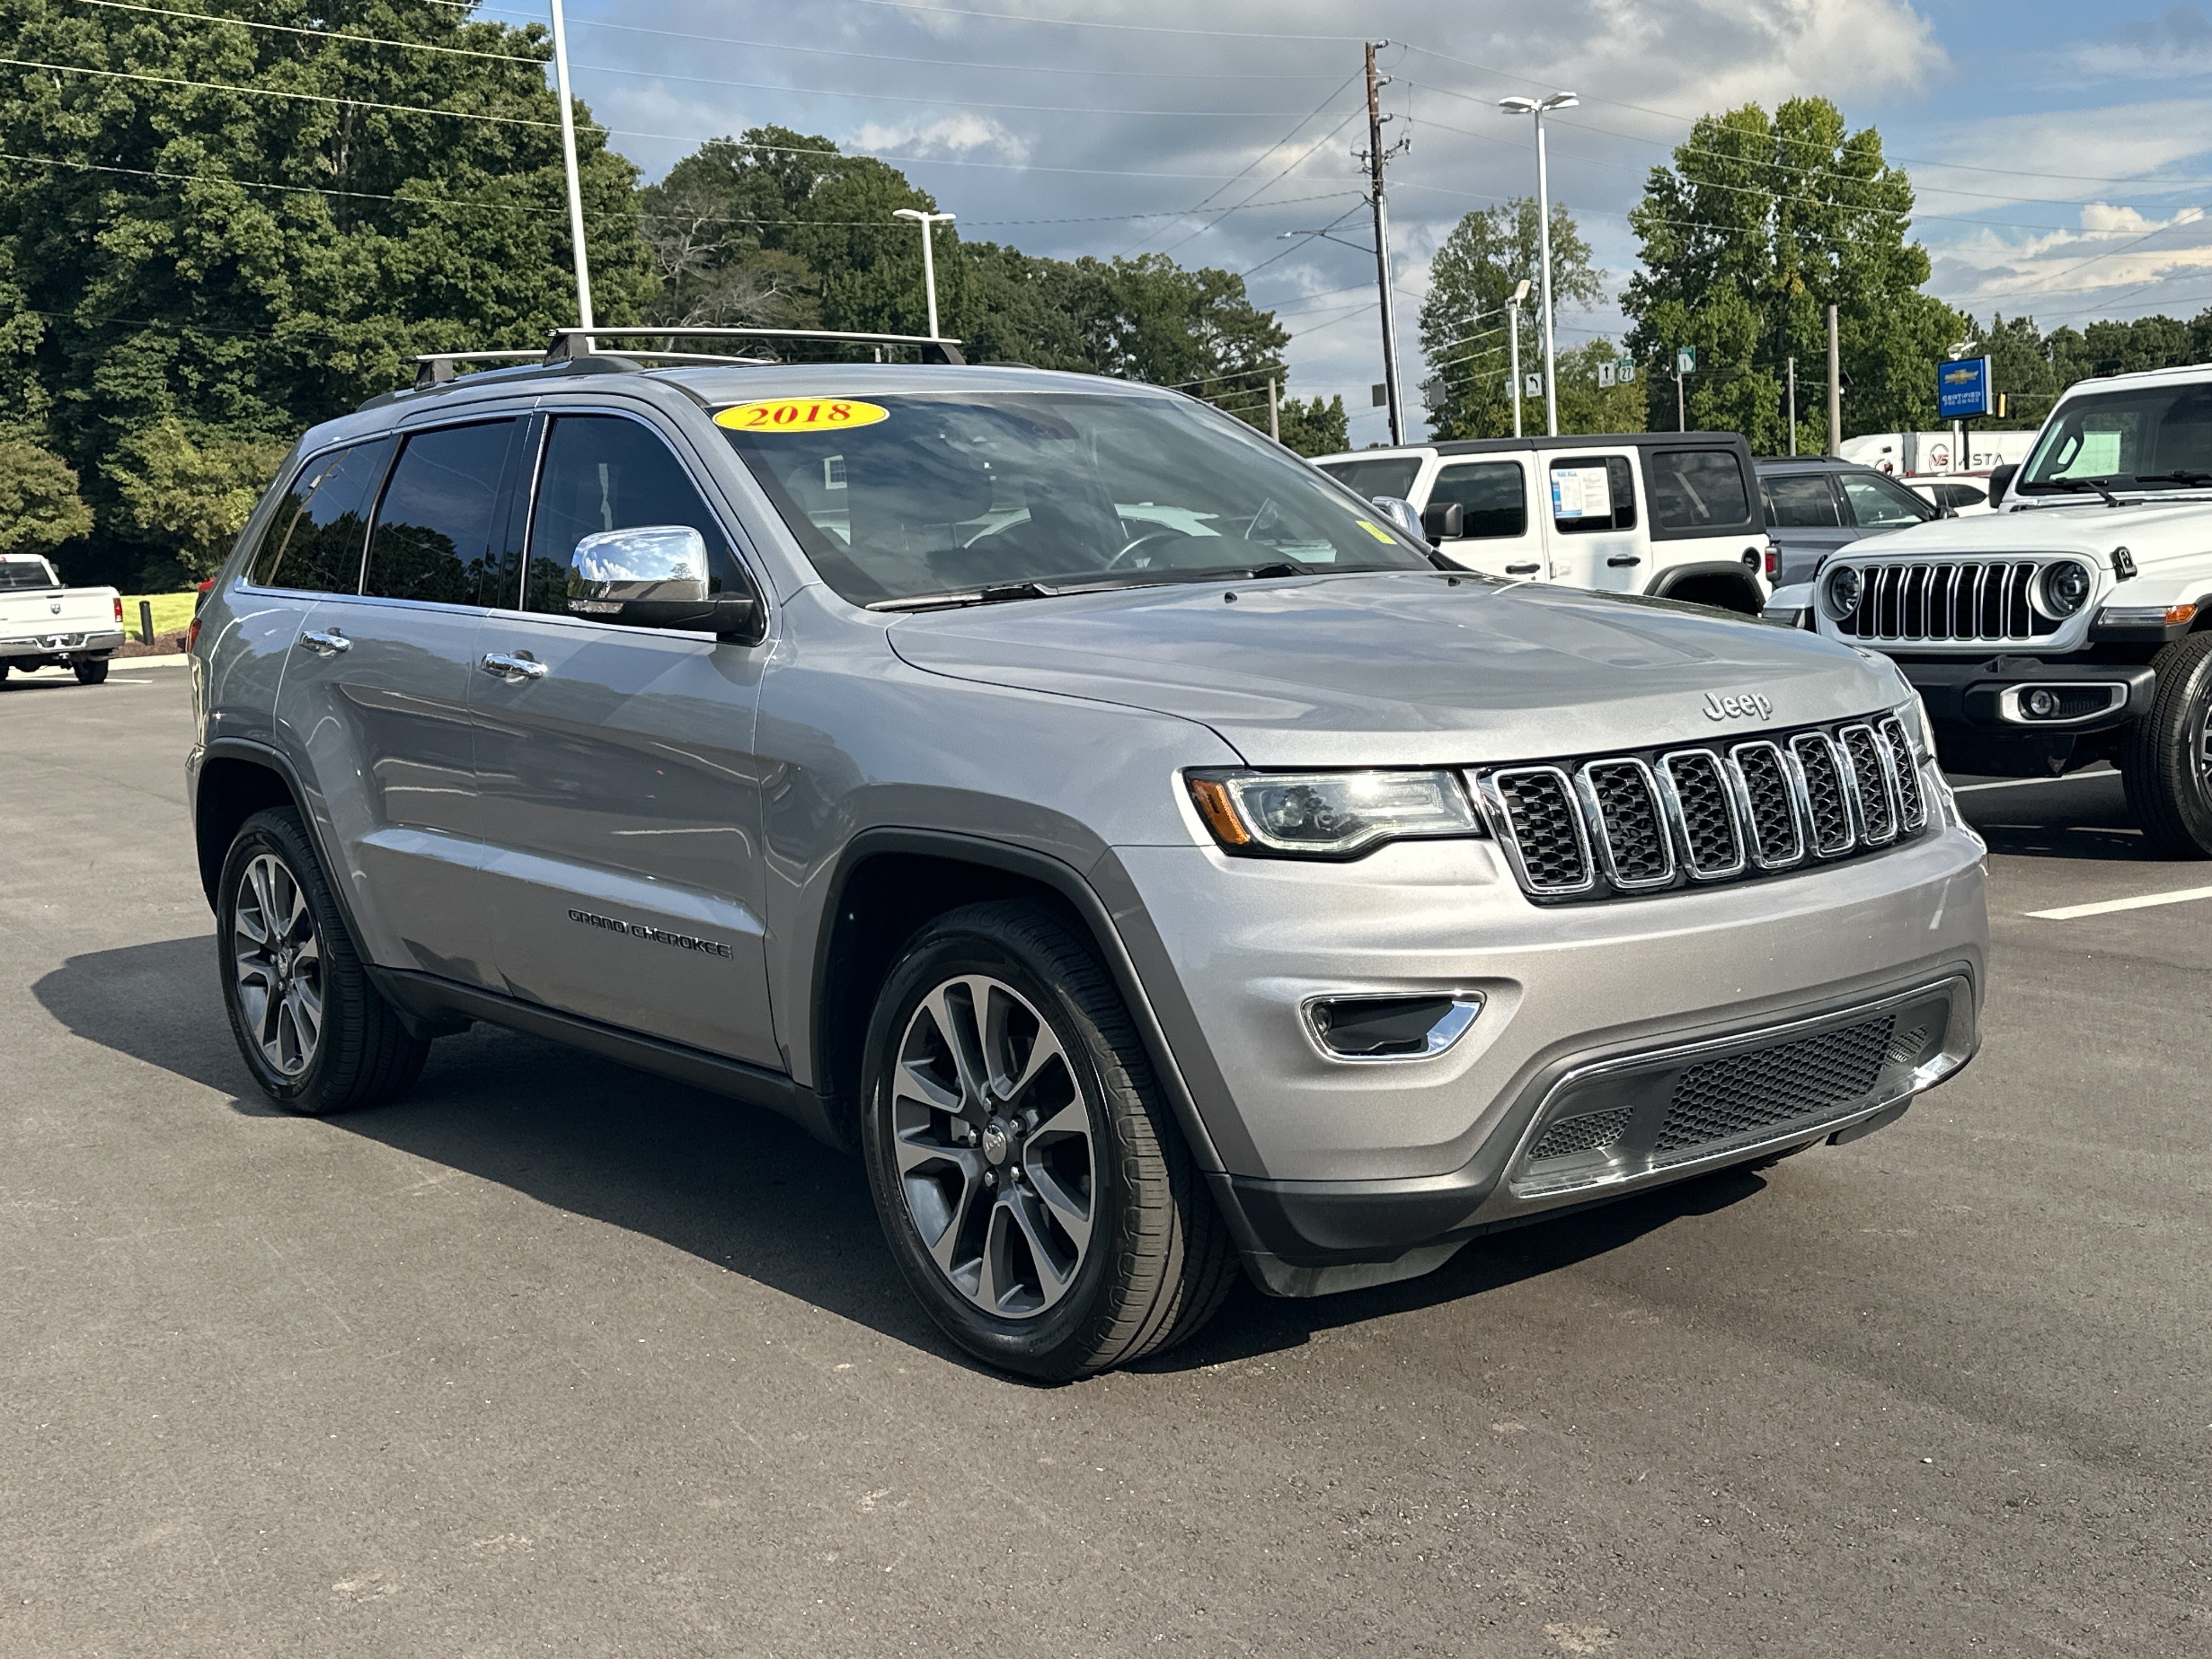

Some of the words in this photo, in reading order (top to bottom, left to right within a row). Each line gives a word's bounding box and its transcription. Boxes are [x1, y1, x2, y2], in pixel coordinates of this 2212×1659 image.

[1622, 368, 1631, 380] 27
[1942, 391, 1981, 402] CERTIFIED
[744, 404, 851, 427] 2018
[1702, 692, 1773, 721] Jeep
[568, 908, 629, 935] GRAND
[631, 923, 733, 960] CHEROKEE
